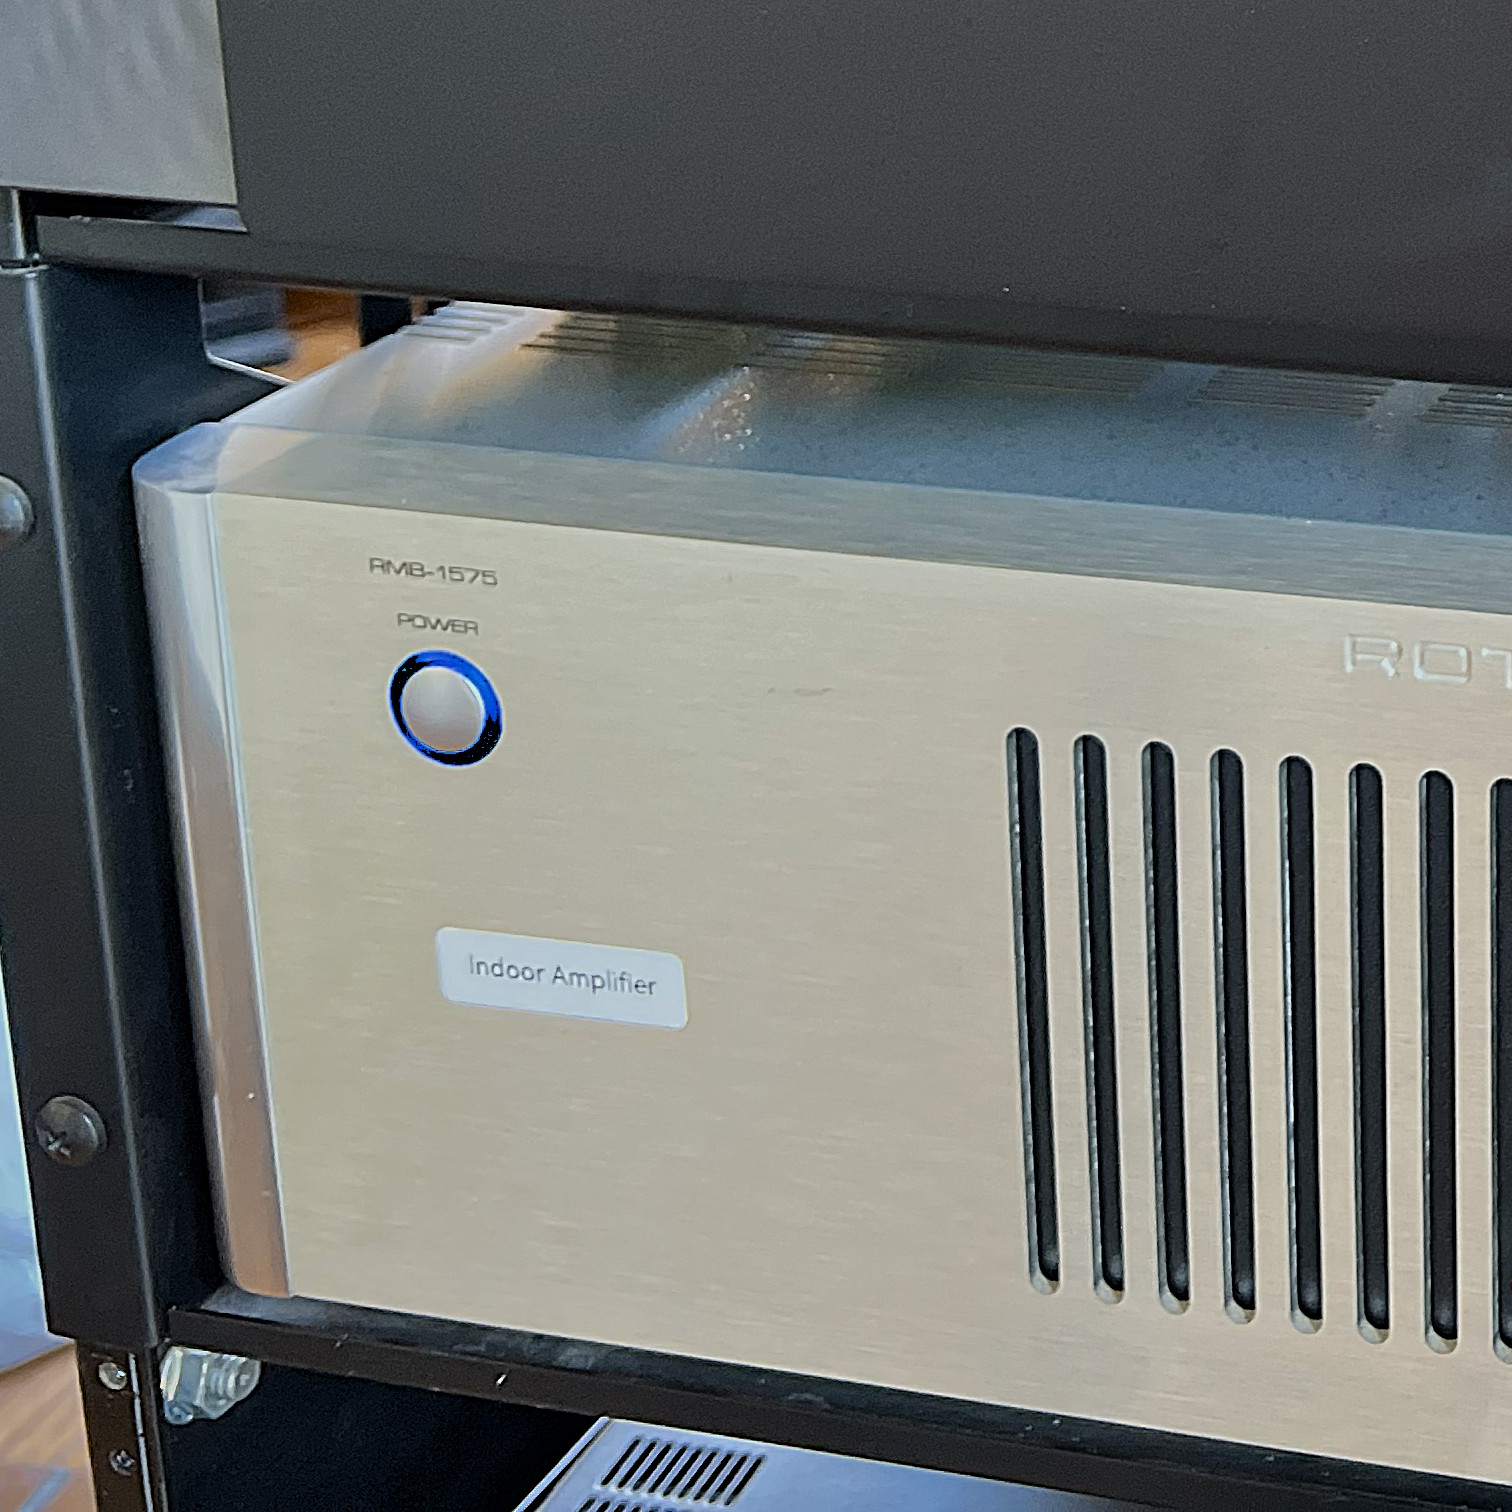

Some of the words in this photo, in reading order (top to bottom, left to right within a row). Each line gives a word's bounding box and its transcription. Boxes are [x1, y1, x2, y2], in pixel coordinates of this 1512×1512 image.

[369, 557, 498, 586] RMB-1575
[397, 612, 479, 636] POWER
[468, 953, 546, 983] Indoor
[552, 964, 657, 996] Amplifier
